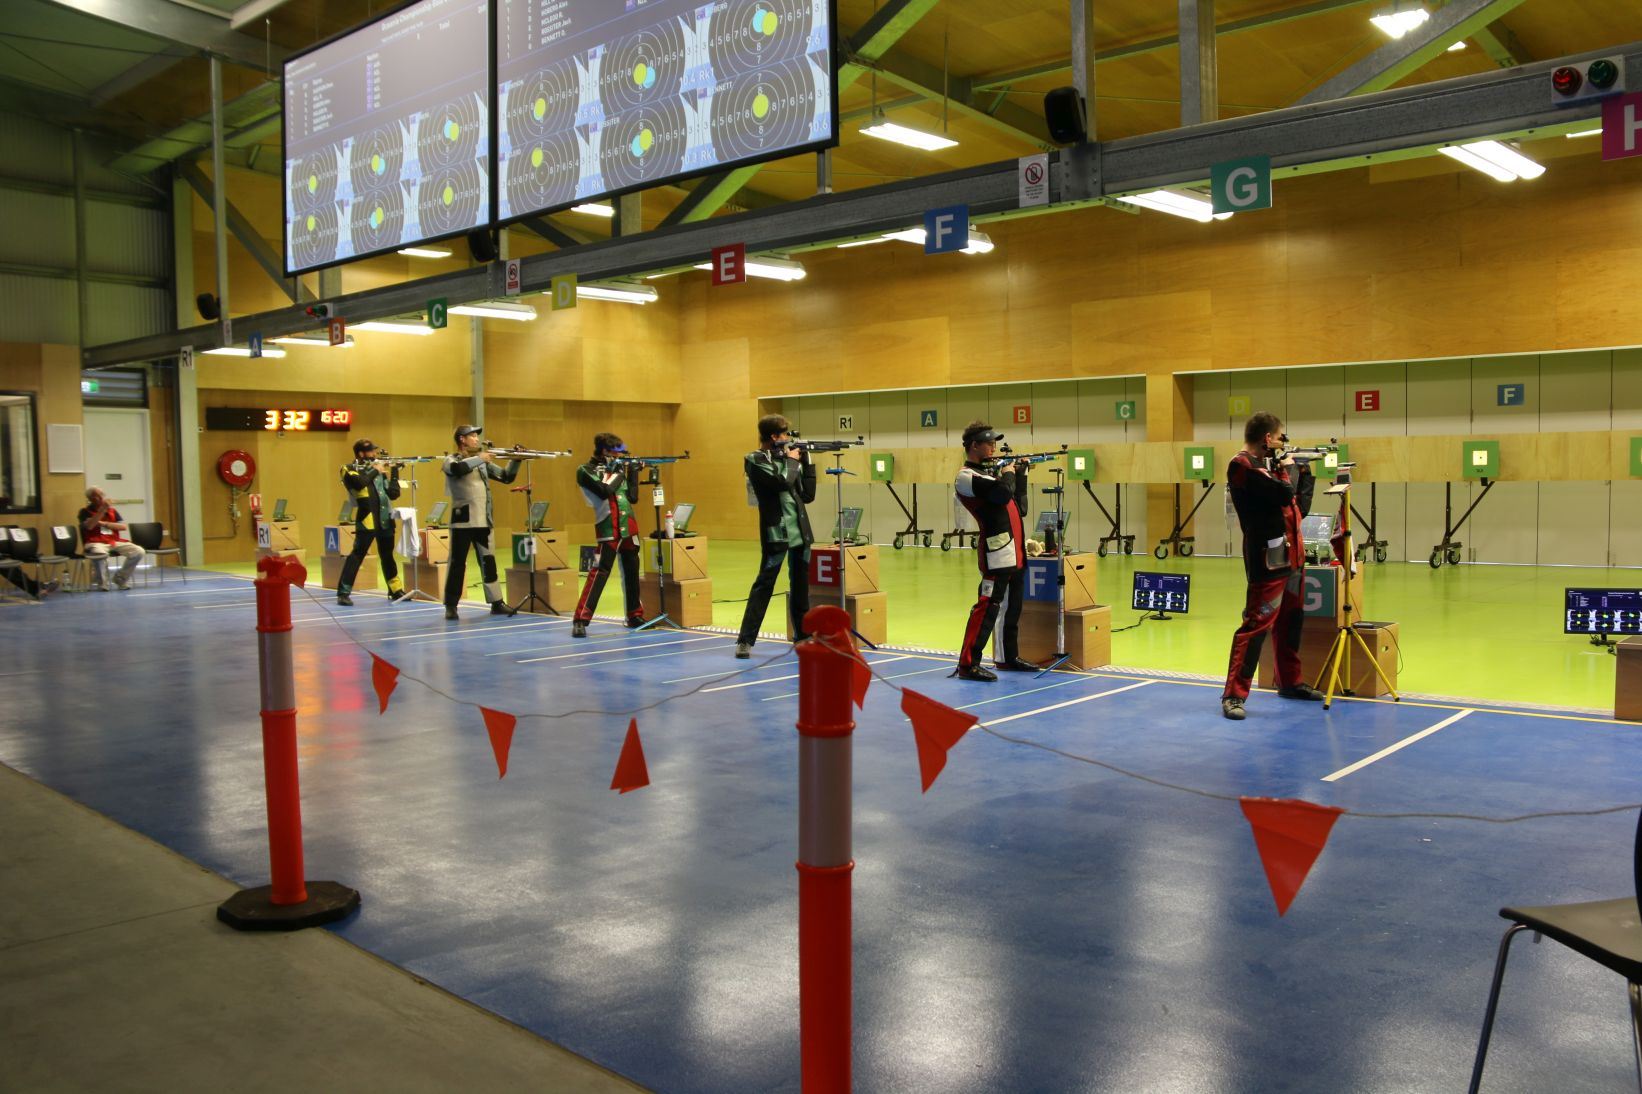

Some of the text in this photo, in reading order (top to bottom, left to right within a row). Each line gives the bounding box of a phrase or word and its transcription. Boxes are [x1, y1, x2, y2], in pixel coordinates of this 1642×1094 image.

[1225, 166, 1258, 207] G
[935, 214, 954, 249] F
[720, 251, 736, 282] E
[558, 281, 571, 306] D
[432, 303, 442, 327] C
[332, 323, 340, 342] B
[252, 338, 259, 354] A
[182, 350, 193, 367] R1
[1361, 394, 1372, 410] E
[1504, 388, 1515, 404] F
[1120, 405, 1130, 417] C
[1234, 399, 1245, 413] D
[840, 417, 852, 429] R1
[925, 414, 934, 425] A
[1017, 408, 1026, 422] B
[259, 528, 270, 543] R1
[328, 535, 337, 549] A
[817, 556, 833, 583] E
[1029, 567, 1047, 597] F
[1303, 576, 1322, 612] G
